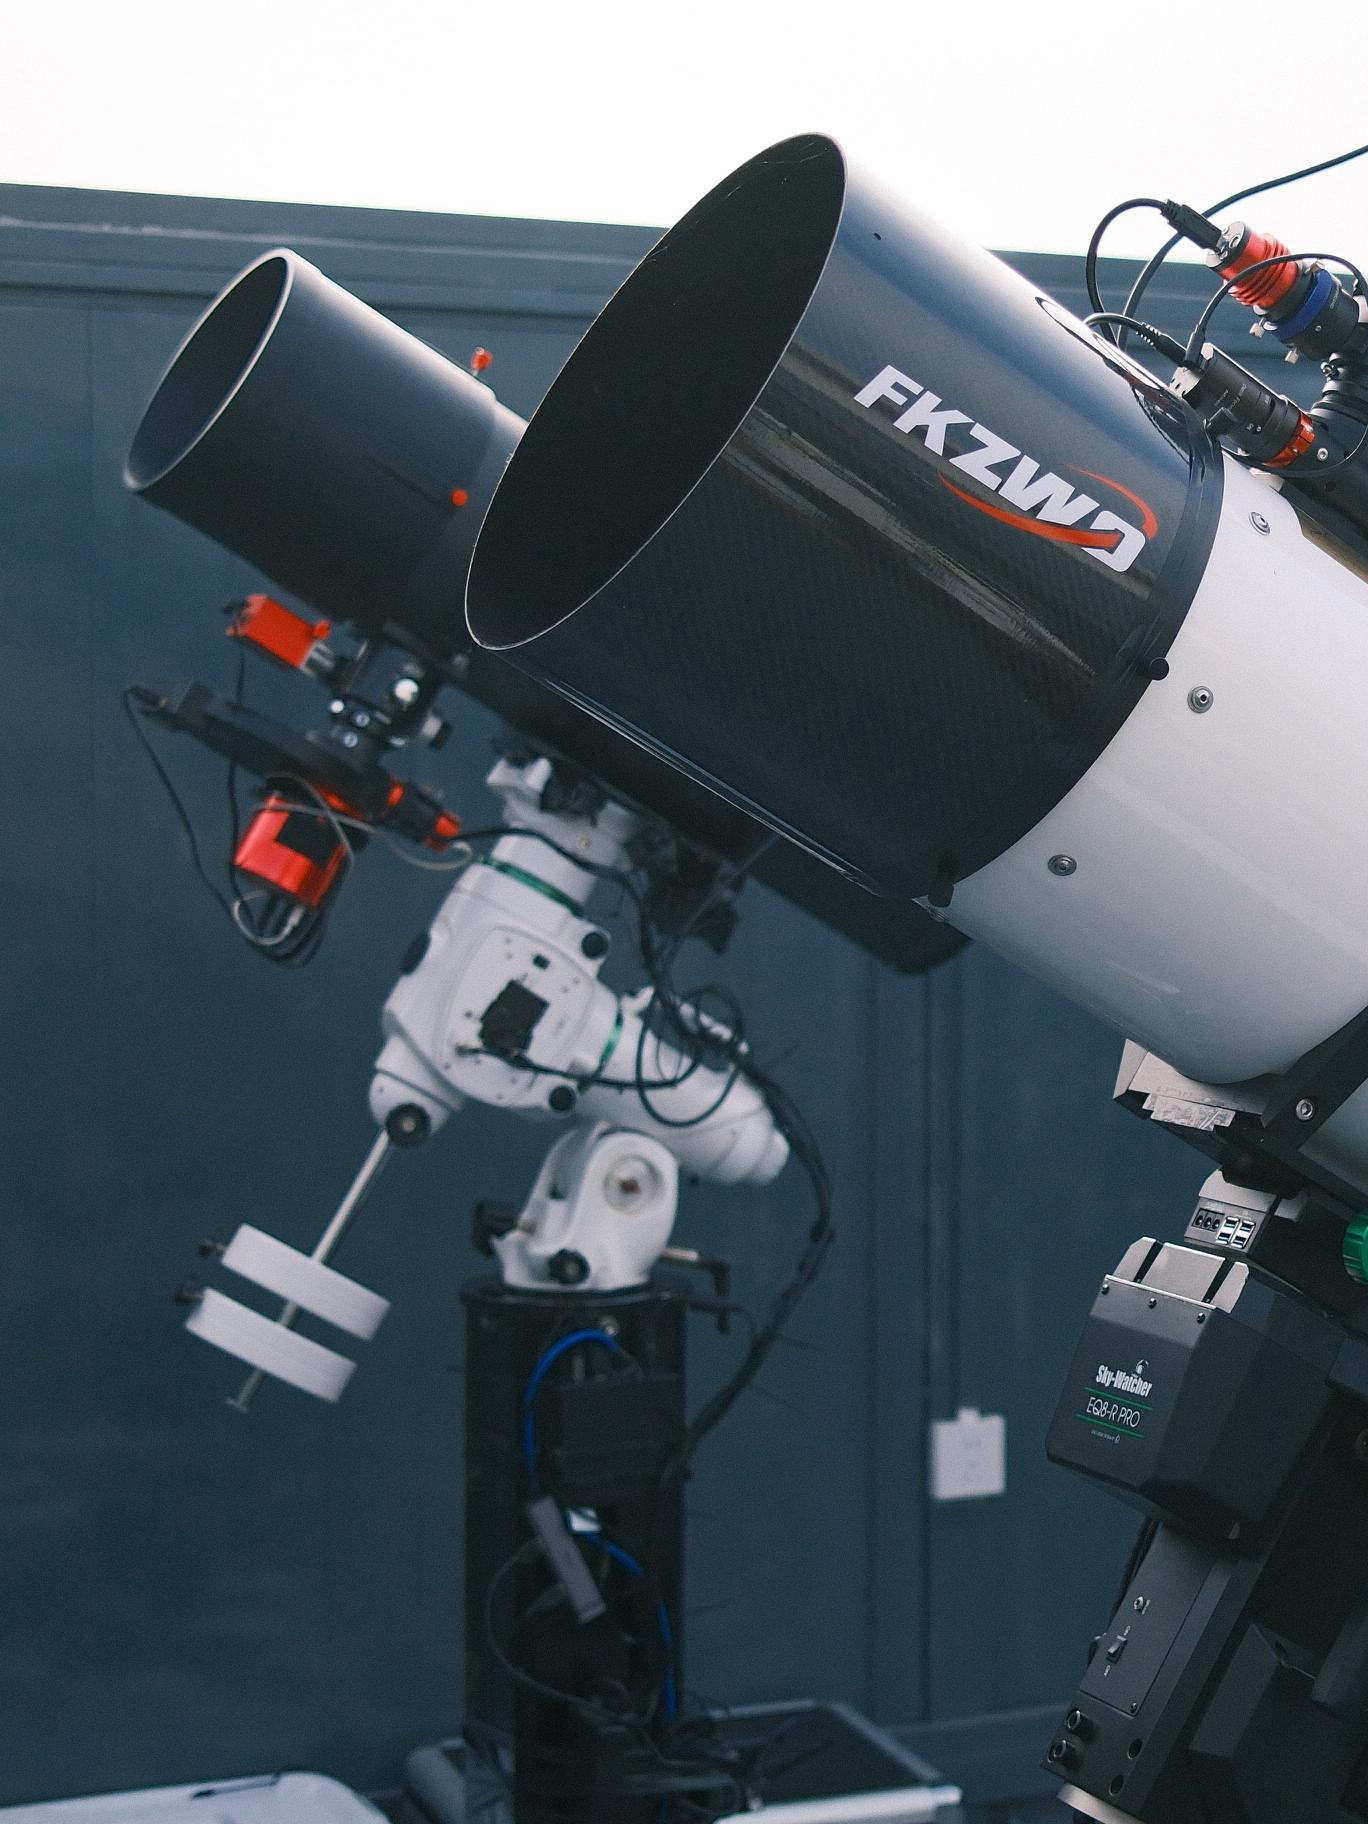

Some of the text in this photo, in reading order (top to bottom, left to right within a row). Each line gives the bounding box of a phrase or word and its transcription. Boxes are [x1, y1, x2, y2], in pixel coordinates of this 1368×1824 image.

[1096, 1364, 1153, 1397] Sky-Watcher
[1086, 1397, 1140, 1427] EQ8-R PRO
